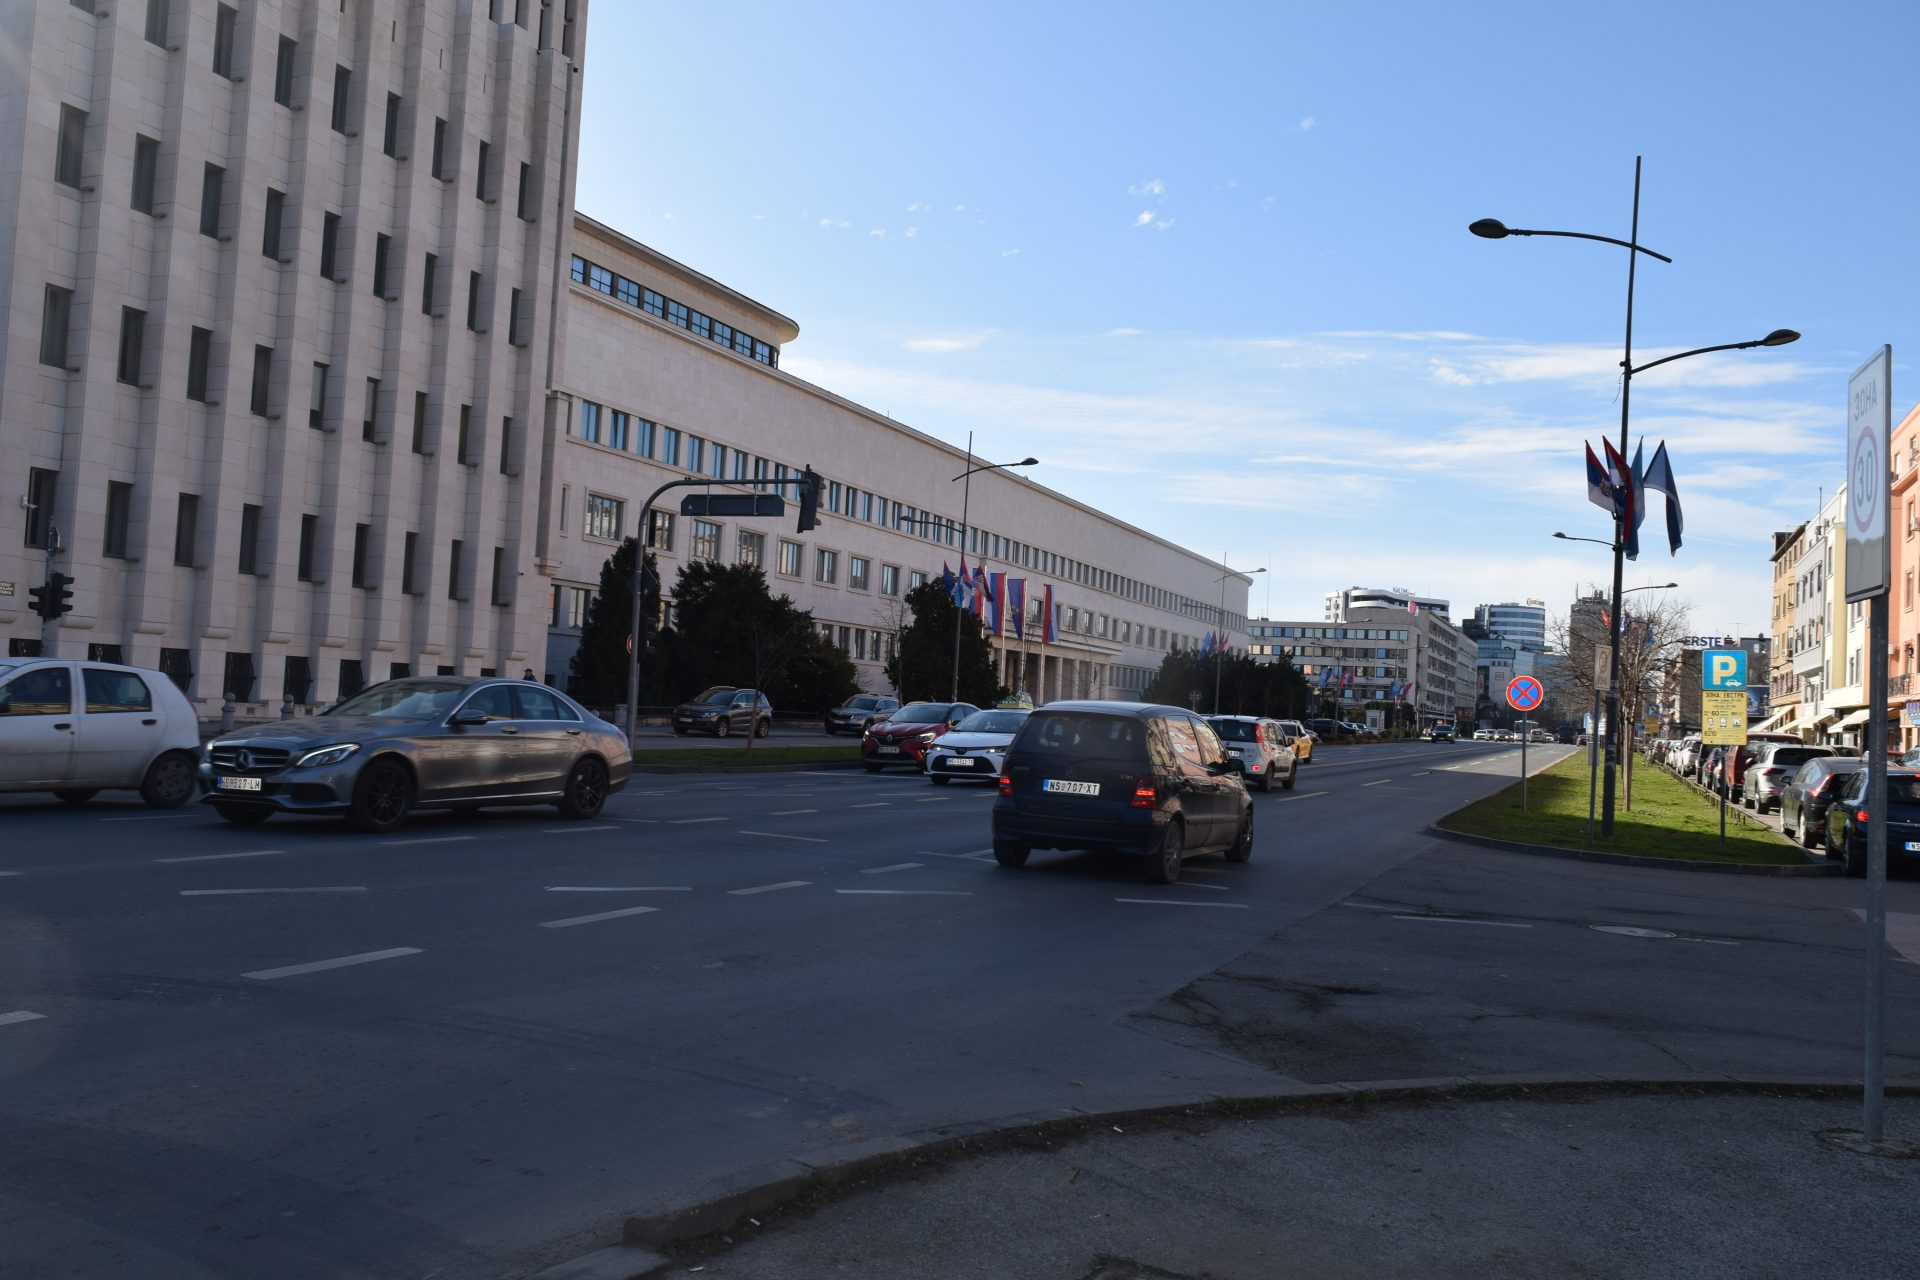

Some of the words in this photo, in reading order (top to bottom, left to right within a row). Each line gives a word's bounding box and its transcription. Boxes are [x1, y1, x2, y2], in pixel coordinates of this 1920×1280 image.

[1855, 378, 1877, 421] ЗОНА
[1857, 450, 1874, 507] 30
[1685, 636, 1721, 647] ERSTE
[1712, 655, 1737, 685] P
